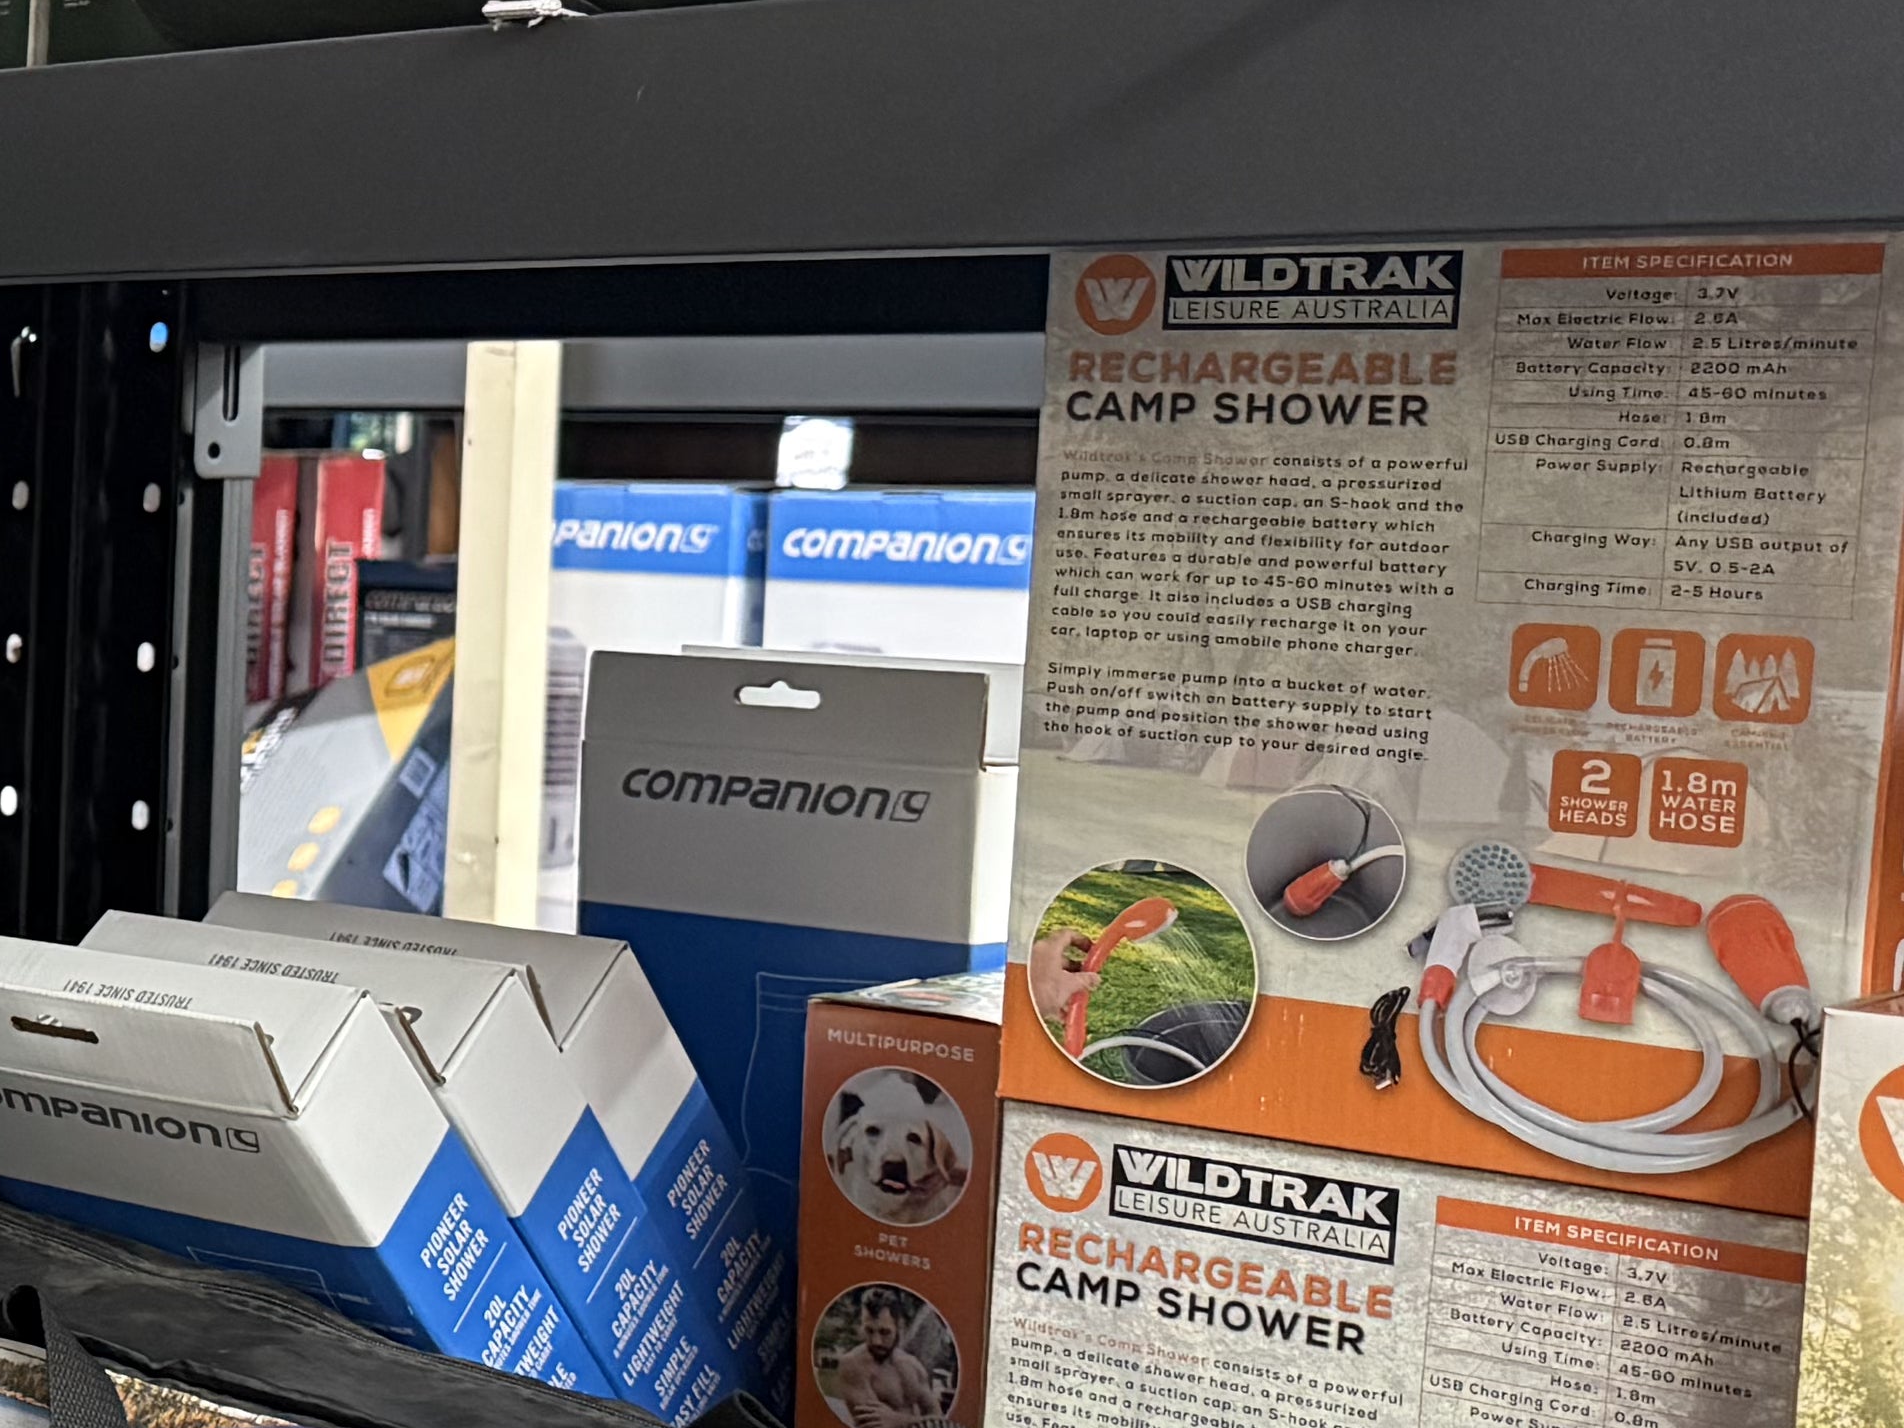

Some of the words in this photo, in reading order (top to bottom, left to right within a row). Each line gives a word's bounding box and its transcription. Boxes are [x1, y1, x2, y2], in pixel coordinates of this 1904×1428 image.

[1171, 256, 1454, 292] WILDTRAK
[1582, 255, 1630, 271] ITEM
[1636, 253, 1793, 269] SPECIFICATION
[1171, 299, 1280, 320] LEISURE
[1291, 299, 1449, 319] AUSTRALIA
[1068, 351, 1458, 385] RECHARGEABLE
[1067, 391, 1195, 423] CAMP
[1213, 393, 1429, 427] SHOWER
[782, 527, 999, 563] companion
[622, 768, 892, 821] companion
[1580, 759, 1612, 795] 2
[1661, 770, 1737, 797] 1.8m
[1560, 796, 1628, 813] SHOWER
[1560, 810, 1626, 827] HEADS
[1660, 811, 1735, 833] HOSE
[1662, 794, 1736, 814] WATER
[208, 954, 235, 967] 1941
[240, 959, 278, 974] SINCE
[281, 964, 339, 984] TRUSTED
[63, 980, 89, 995] 1941
[95, 984, 131, 1002] SINCE
[828, 1028, 974, 1063] MULTIPURPOSE
[666, 1140, 711, 1208] PIONEER
[681, 1164, 715, 1217] SOLAR
[1117, 1149, 1391, 1225] WILDTRAK
[556, 1168, 603, 1241] PIONEER
[572, 1193, 609, 1248] SOLAR
[686, 1173, 729, 1240] SHOWER
[1119, 1189, 1222, 1225] LEISURE
[1233, 1209, 1386, 1254] AUSTRALIA
[420, 1193, 469, 1268] PIONEER
[436, 1219, 474, 1276] SOLAR
[578, 1203, 622, 1273] SHOWER
[878, 1233, 908, 1249] PET
[1515, 1216, 1561, 1238] ITEM
[1567, 1224, 1719, 1262] SPECIFICATION
[443, 1229, 490, 1301] SHOWER
[716, 1229, 762, 1305] CAPACITY
[720, 1237, 742, 1267] 20L
[853, 1244, 931, 1270] SHOWERS
[1019, 1222, 1394, 1318] RECHARGEABLE
[1538, 1252, 1609, 1277] Voltage:
[1626, 1266, 1668, 1285] 3.7V
[611, 1260, 659, 1339] CAPACITY
[615, 1268, 637, 1299] 20L
[484, 1295, 506, 1329] 20L
[1017, 1262, 1141, 1309] CAMP
[1157, 1287, 1366, 1355] SHOWER
[1500, 1293, 1553, 1313] Water
[481, 1285, 531, 1367] CAPACITY
[622, 1280, 686, 1386] LIGHTWEIGHT
[1450, 1307, 1514, 1333] Battery
[1520, 1321, 1602, 1349] Capacity:
[1620, 1338, 1669, 1357] 2200
[1675, 1350, 1714, 1368] mAh
[654, 1335, 691, 1397] SIMPLE
